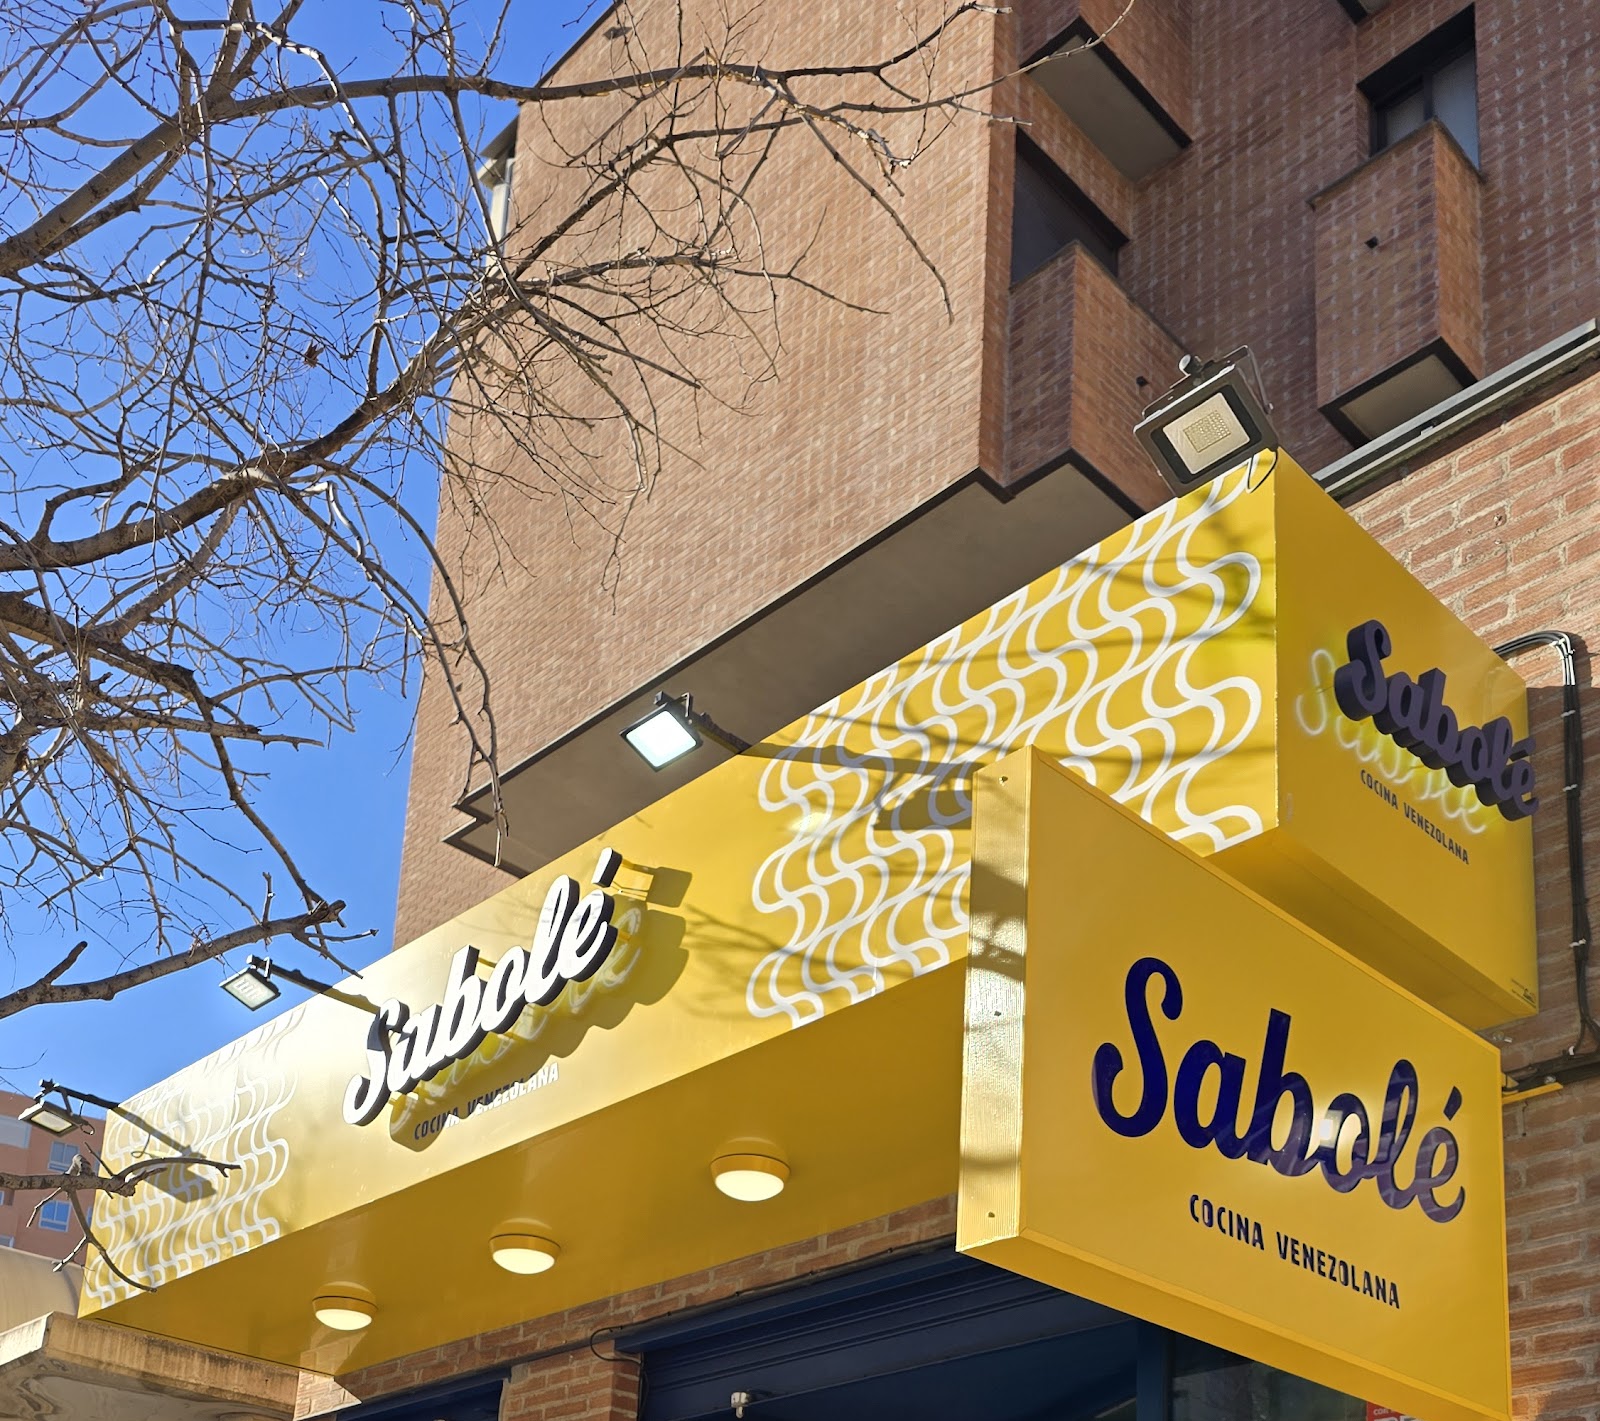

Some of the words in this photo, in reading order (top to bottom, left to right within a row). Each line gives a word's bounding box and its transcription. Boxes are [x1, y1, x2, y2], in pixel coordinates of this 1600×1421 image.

[1334, 620, 1539, 821] Sabolé
[1360, 769, 1398, 810] COCINA
[1403, 801, 1469, 865] VENEZOLANA
[342, 847, 622, 1126] Sabolé
[414, 1107, 460, 1140] COCINA
[466, 1062, 560, 1117] VENEZOLANA
[1091, 957, 1465, 1223] Sabolé
[1189, 1194, 1265, 1251] COCINA
[1276, 1231, 1400, 1309] VENEZOLANA
